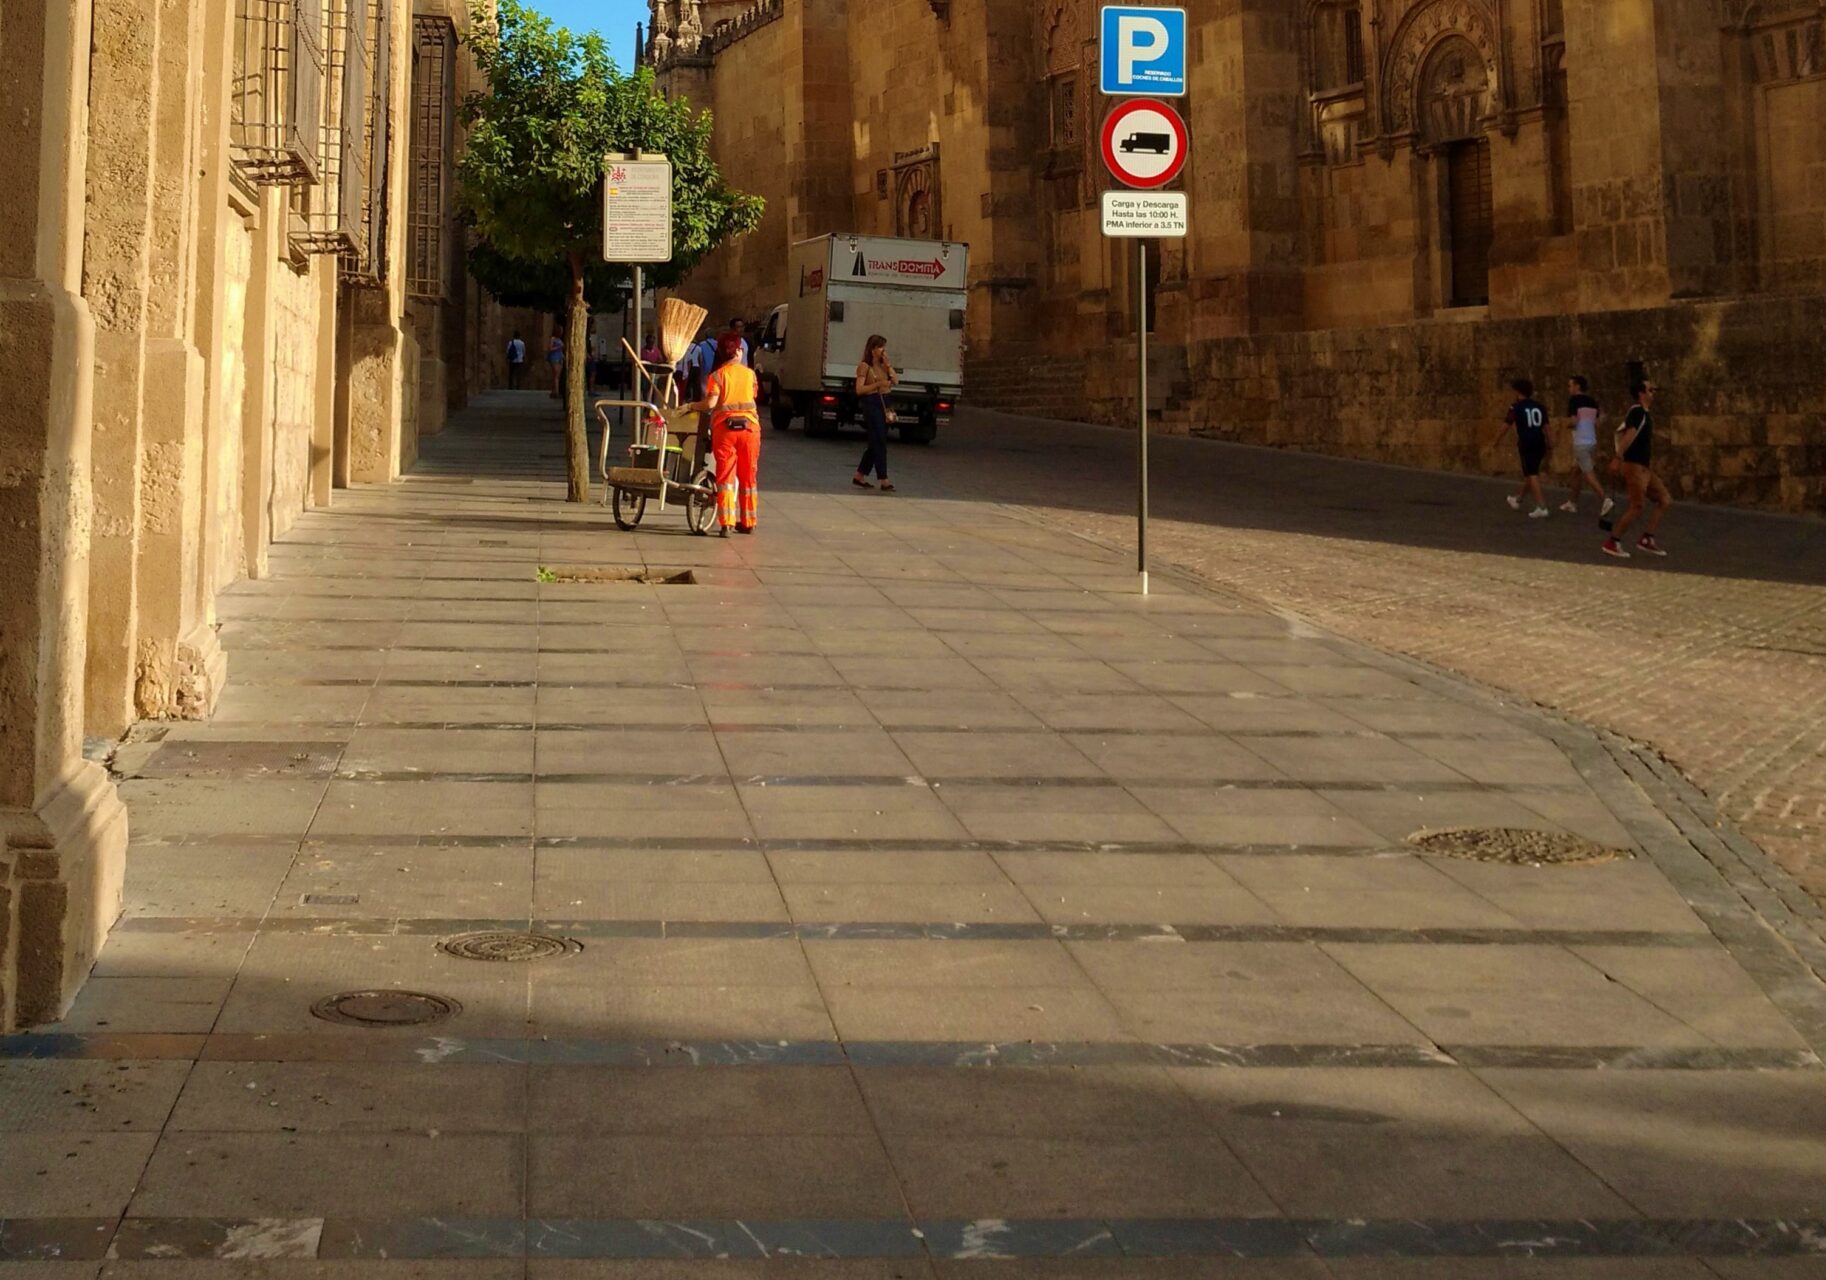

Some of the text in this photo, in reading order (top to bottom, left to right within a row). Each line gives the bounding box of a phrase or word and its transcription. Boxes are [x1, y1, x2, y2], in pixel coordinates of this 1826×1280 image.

[1118, 16, 1169, 84] P
[1112, 200, 1135, 209] Carga
[1143, 200, 1179, 210] Descarga
[1112, 210, 1178, 219] Hasta las 10:00 H.
[1106, 220, 1124, 228] PMA
[1160, 221, 1172, 229] 3.5
[1173, 221, 1184, 229] TN
[1525, 408, 1542, 427] 10
